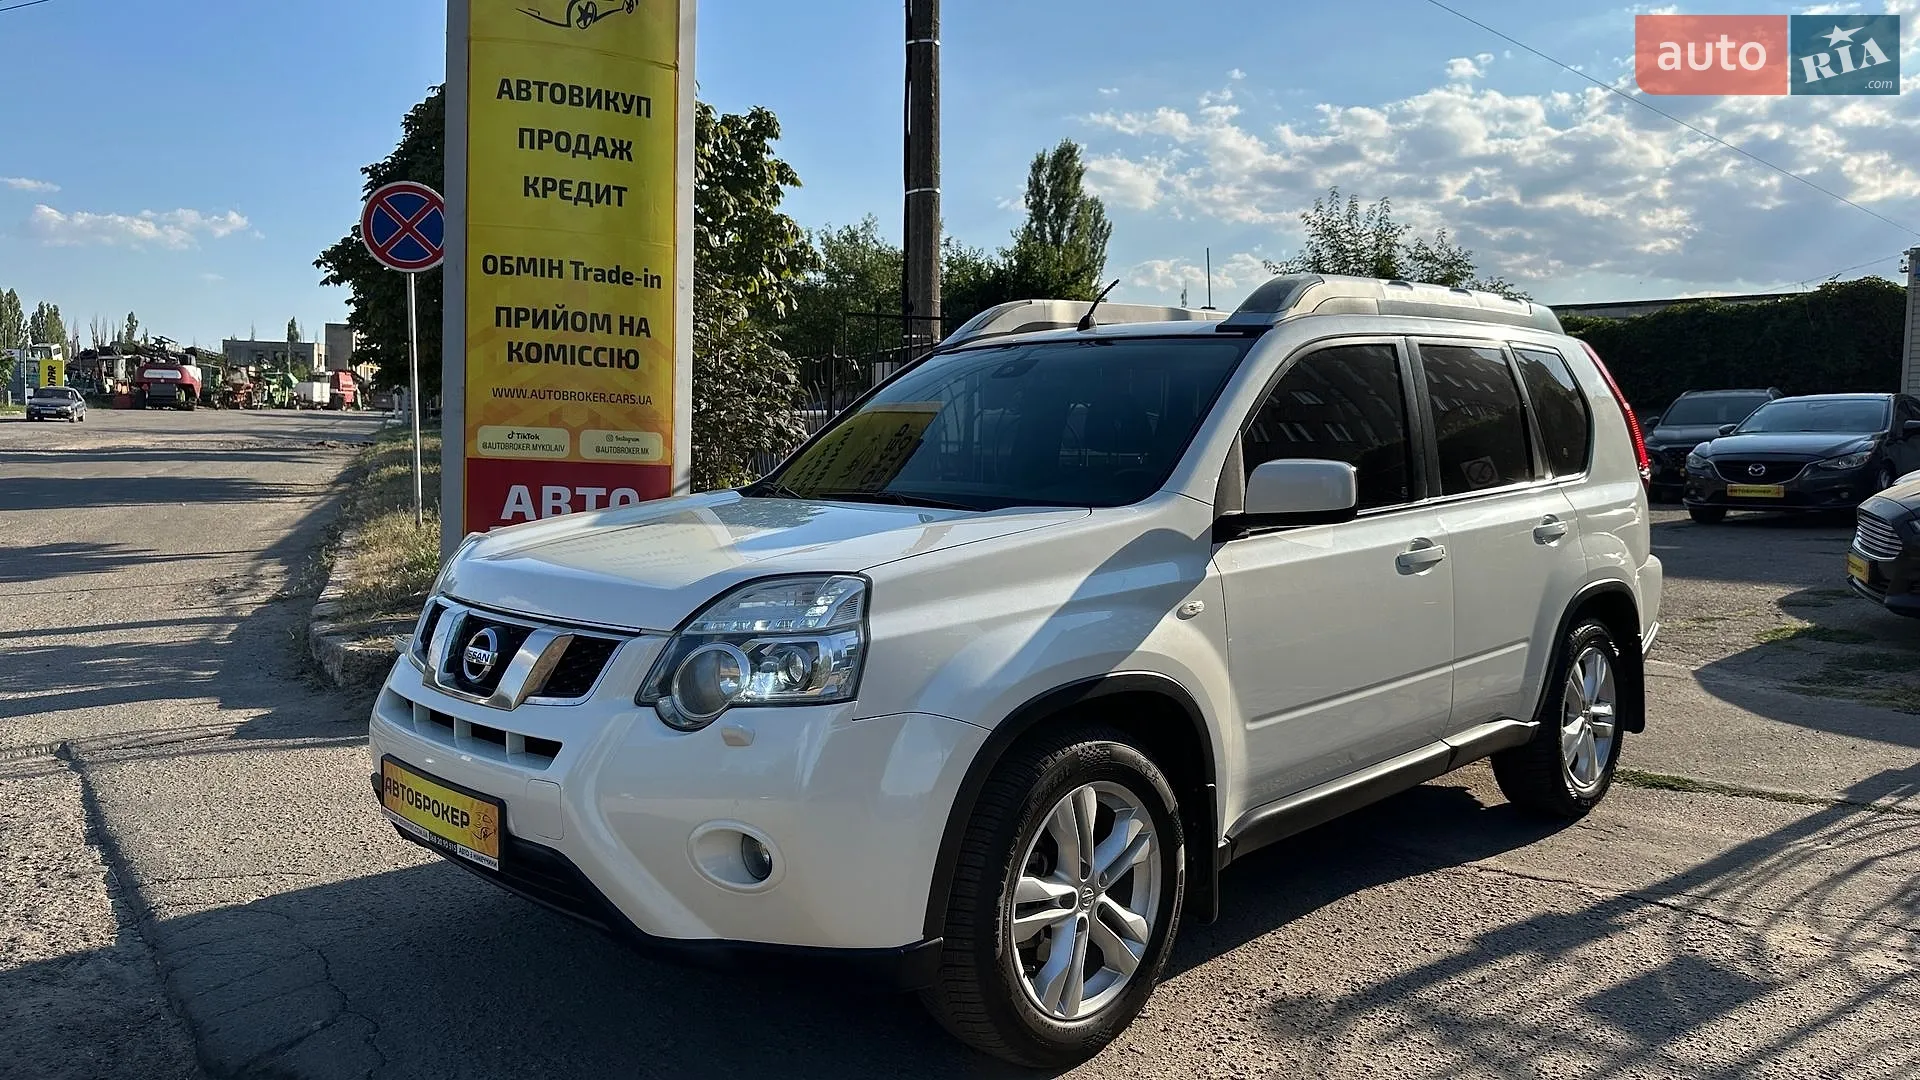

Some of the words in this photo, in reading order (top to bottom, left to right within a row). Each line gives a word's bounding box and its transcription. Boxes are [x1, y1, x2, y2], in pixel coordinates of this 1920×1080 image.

[496, 78, 652, 119] АВТОВИКУП
[518, 127, 634, 162] ПРОДАЖ
[523, 175, 628, 208] КРЕДИТ
[481, 254, 564, 279] ОБМІН
[569, 260, 662, 289] Trade-in
[495, 303, 612, 335] ПРИЙОМ
[619, 315, 652, 339] НА
[507, 341, 640, 370] КОМІССІЮ
[492, 387, 653, 406] WWW.AUTOBROKER.CARS.UA
[516, 432, 540, 441] TikTok
[468, 649, 491, 663] SSAN
[385, 776, 471, 829] АВТОБРОКЕР
